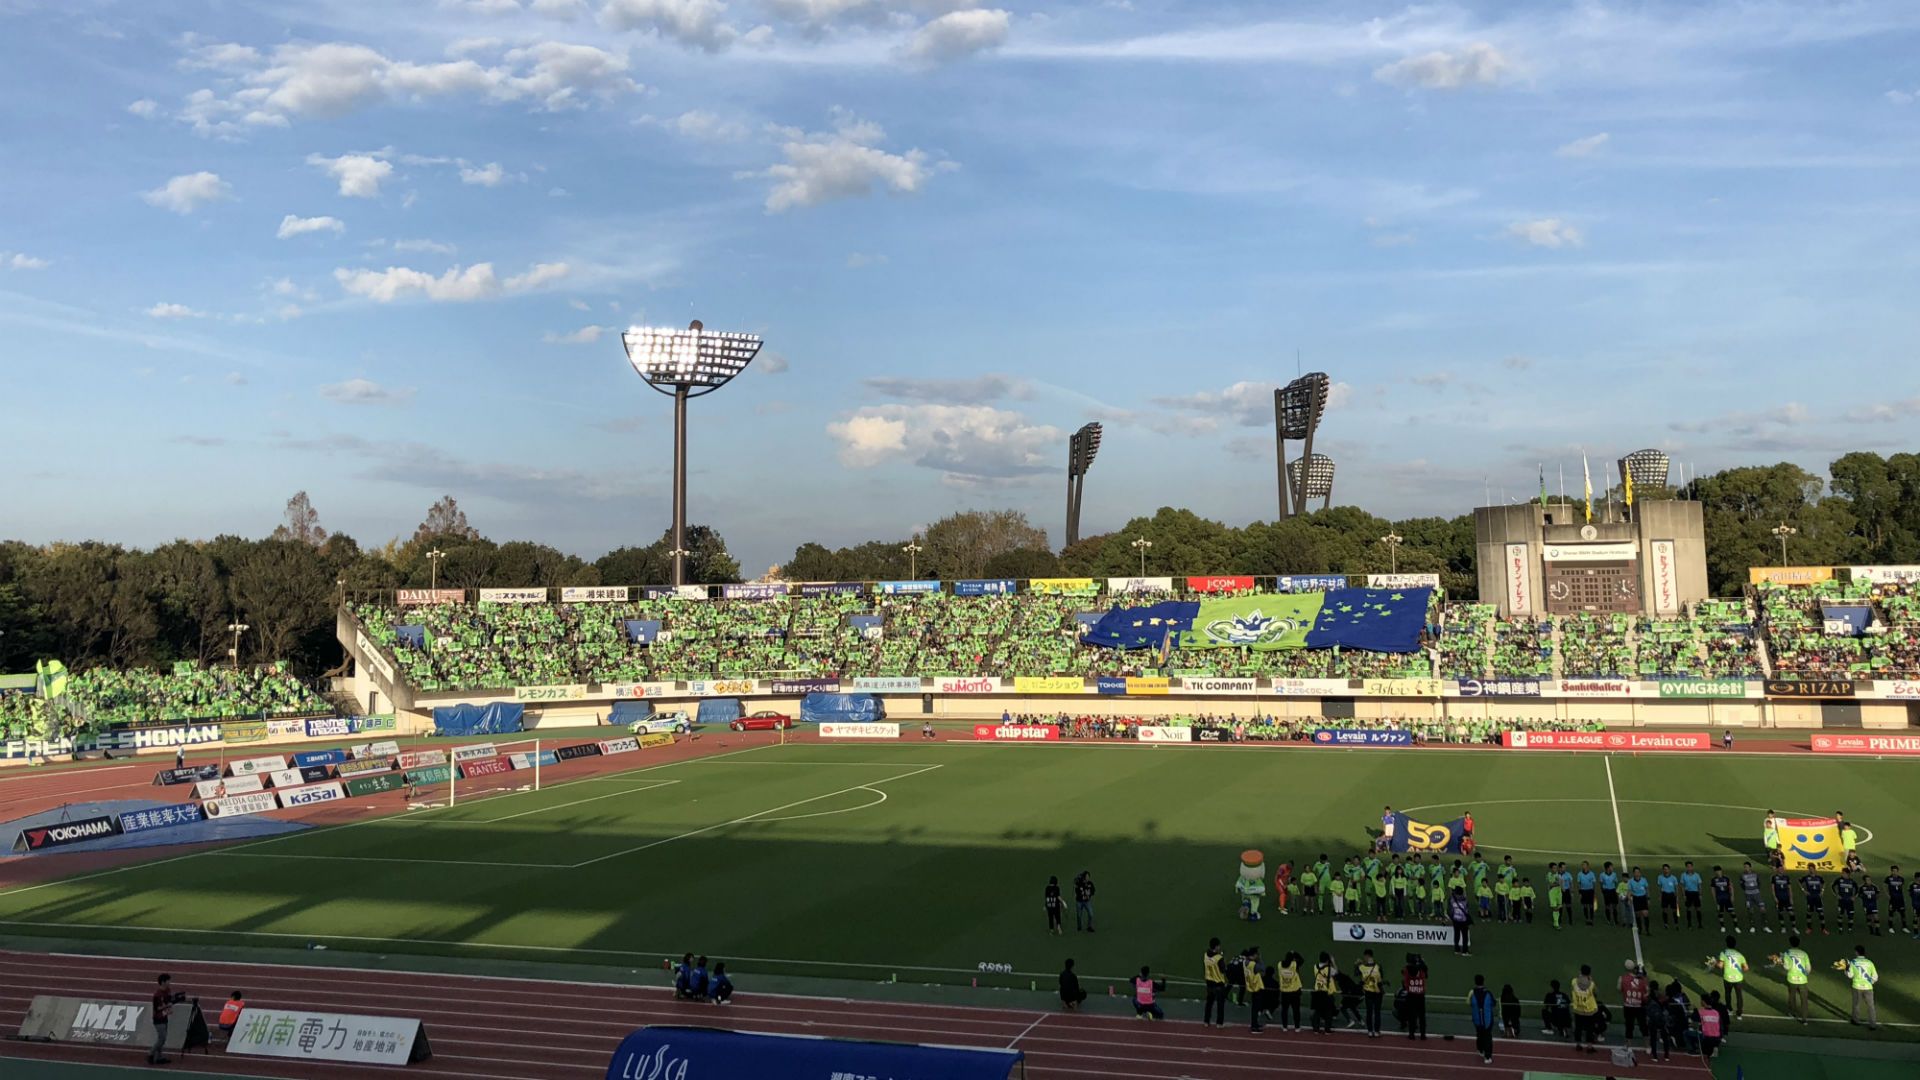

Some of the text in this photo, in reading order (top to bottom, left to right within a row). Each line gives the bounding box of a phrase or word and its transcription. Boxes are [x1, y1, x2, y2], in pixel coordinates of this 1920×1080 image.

[1207, 579, 1235, 589] J:COM
[400, 590, 440, 600] DAIYU
[587, 589, 626, 599] 湘栄建設
[943, 679, 993, 692] SUMOTTO
[1098, 682, 1126, 690] TOKKEI
[1190, 681, 1254, 691] TK COMPANY
[1799, 682, 1851, 694] RIZAP
[118, 725, 218, 749] SHONAN
[836, 725, 898, 736] ヤマザキビスケット
[995, 725, 1021, 740] chip
[1022, 726, 1050, 738] star
[1161, 728, 1184, 740] Noir
[1336, 730, 1367, 740] Levain
[1371, 733, 1406, 742] ルヴァン
[1530, 735, 1554, 744] 2018
[1558, 735, 1604, 744] J.LEAGUE
[1632, 735, 1674, 746] Levain
[1675, 737, 1698, 747] CUP
[468, 762, 507, 777] RANTEC
[218, 792, 272, 807] MELDIA GROUP
[123, 804, 200, 831] 産業能率大学
[47, 820, 112, 842] YOKOHAMA
[1408, 819, 1451, 850] 50
[1373, 928, 1448, 942] Shonan BMW
[72, 1003, 144, 1032] IMEX
[239, 1012, 348, 1054] 湘南電力
[353, 1038, 396, 1054] 地産地消
[623, 1044, 689, 1080] LUSCA
